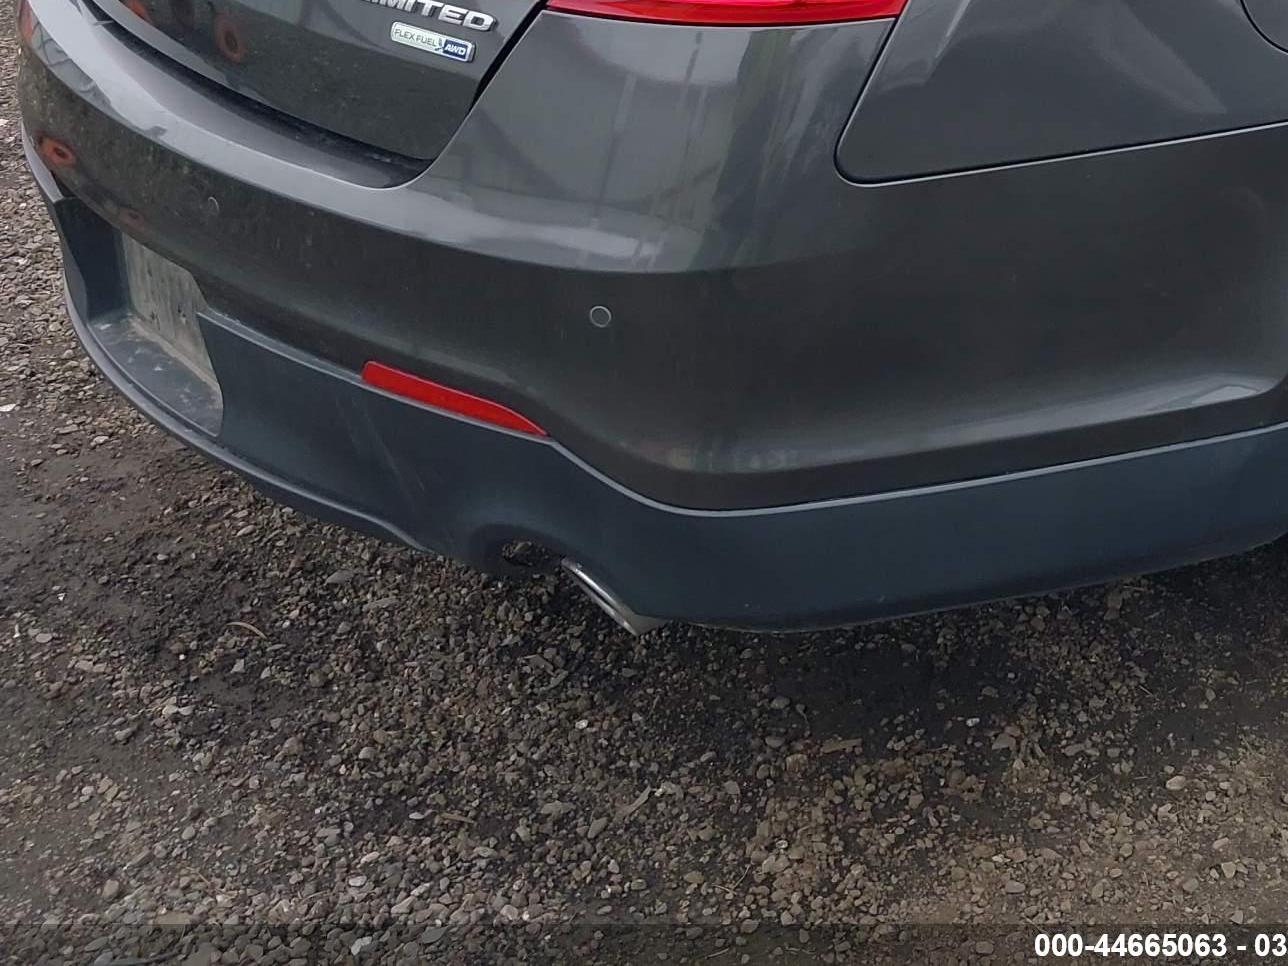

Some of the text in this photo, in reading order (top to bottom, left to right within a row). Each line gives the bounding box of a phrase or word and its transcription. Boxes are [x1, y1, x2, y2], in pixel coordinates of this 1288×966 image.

[394, 28, 467, 56] FLEX FUEL AWD
